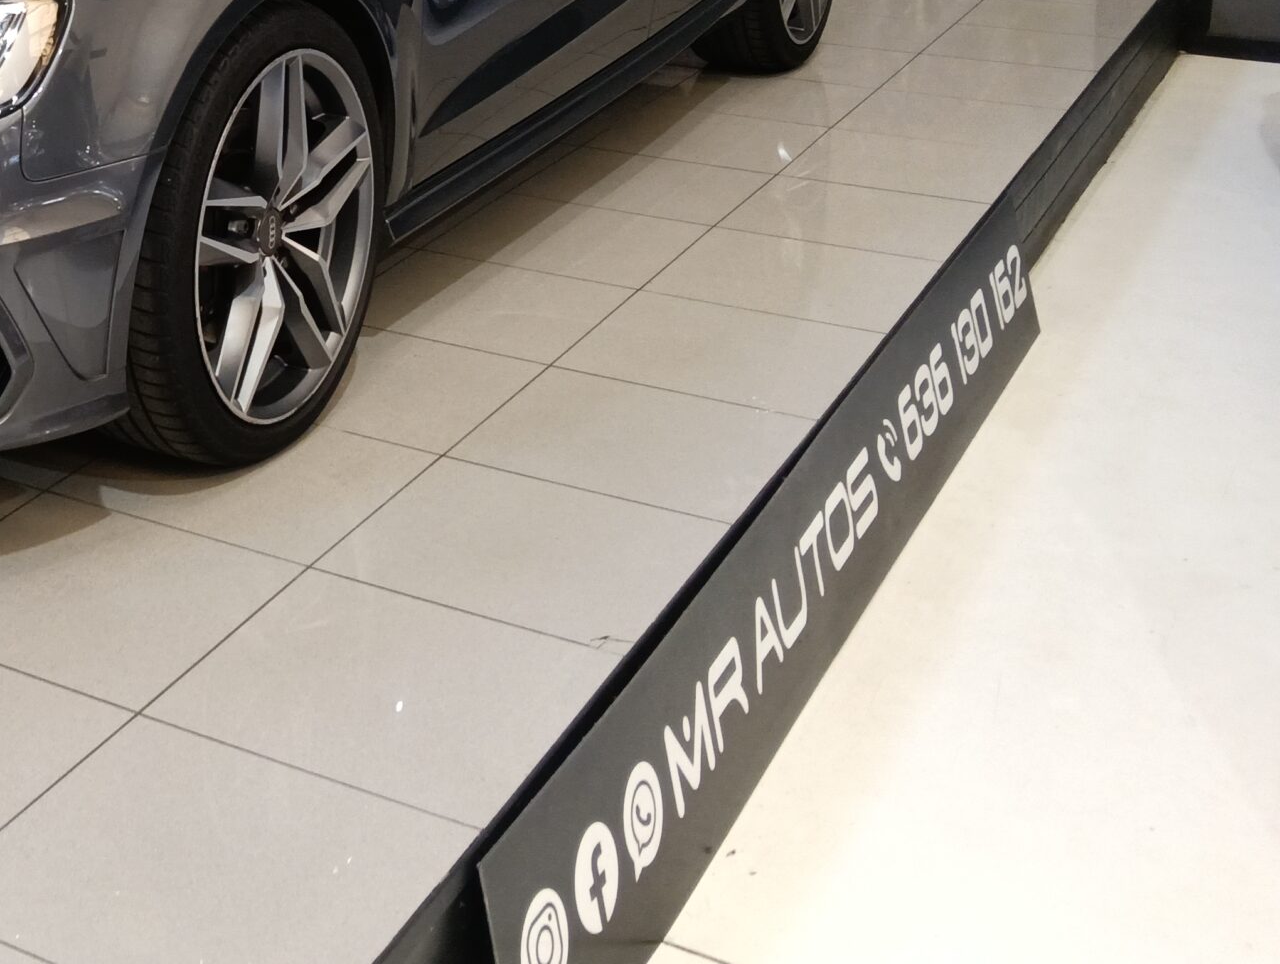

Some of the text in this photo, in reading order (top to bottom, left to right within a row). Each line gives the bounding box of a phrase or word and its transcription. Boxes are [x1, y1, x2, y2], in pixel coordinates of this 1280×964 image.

[664, 244, 1028, 818] MR AUTOS 636 130 162
